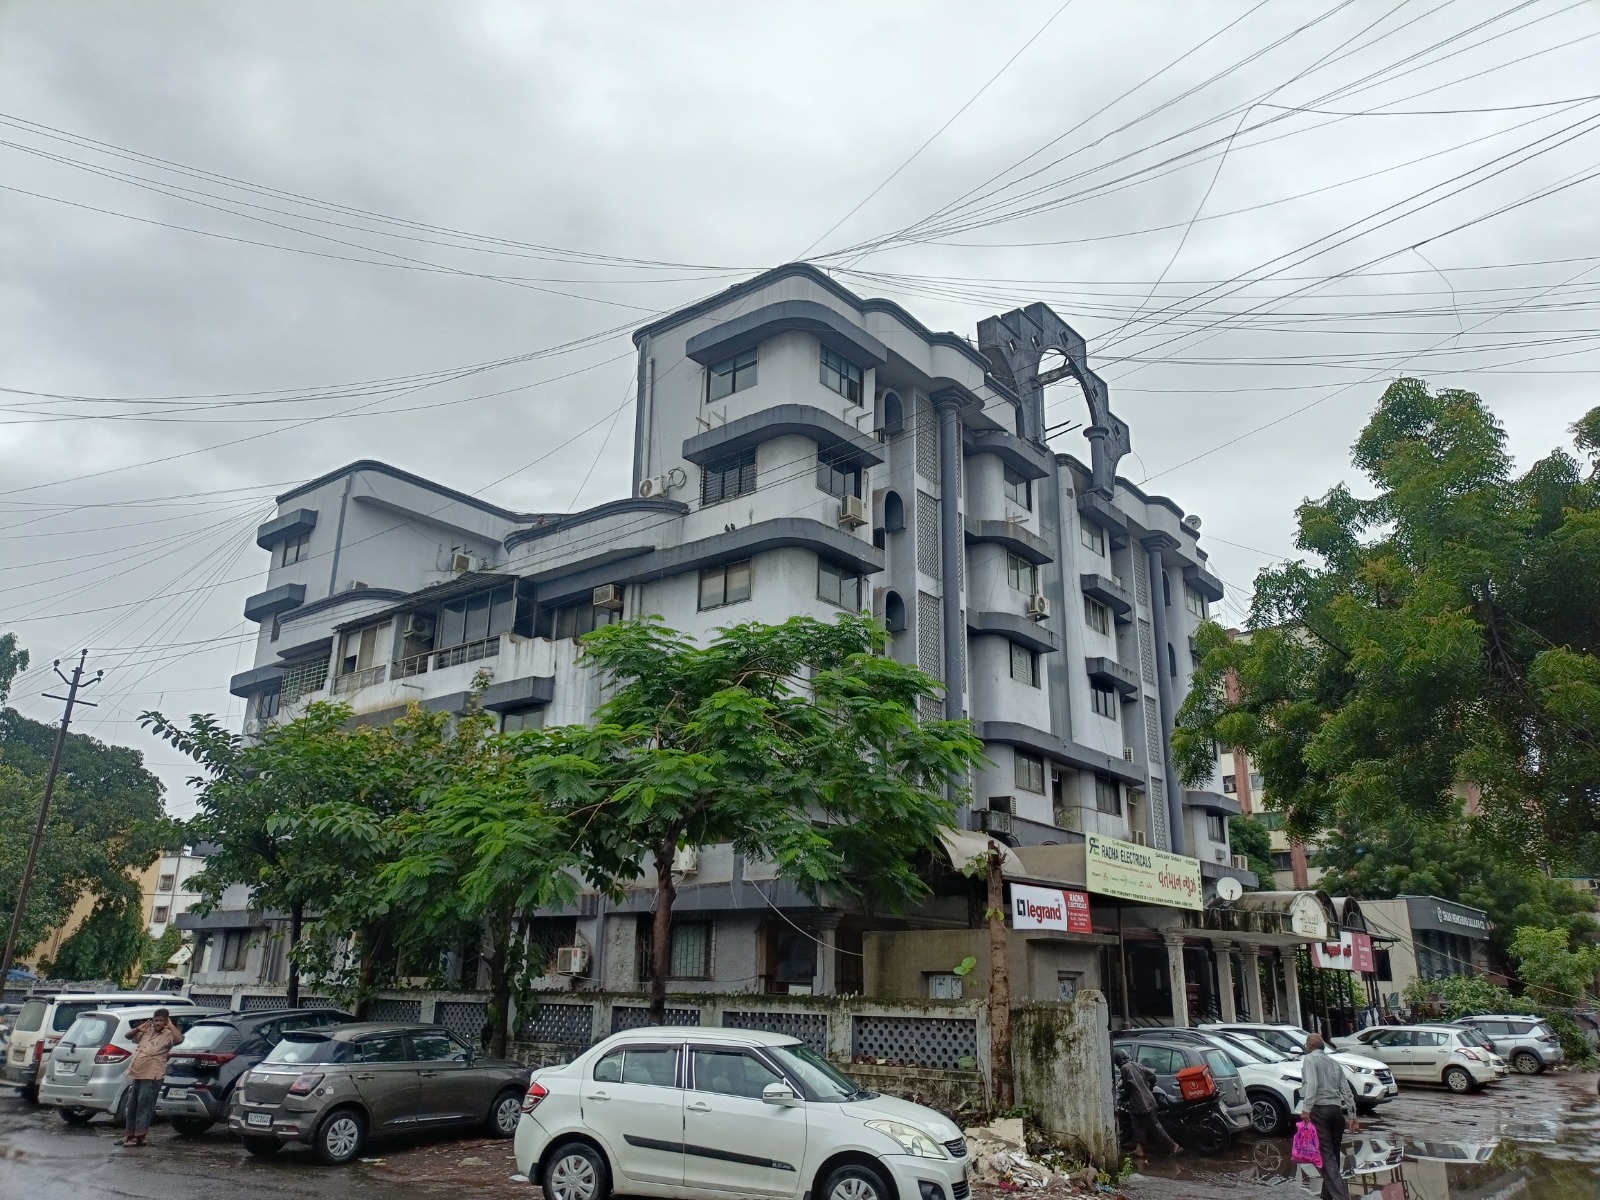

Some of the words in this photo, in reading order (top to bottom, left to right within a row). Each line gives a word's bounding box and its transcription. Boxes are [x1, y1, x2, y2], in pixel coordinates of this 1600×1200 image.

[1102, 845, 1119, 861] RADHA
[1121, 850, 1152, 869] ELECTRICALS
[1069, 893, 1085, 903] RADHA
[1026, 899, 1062, 924] legrand
